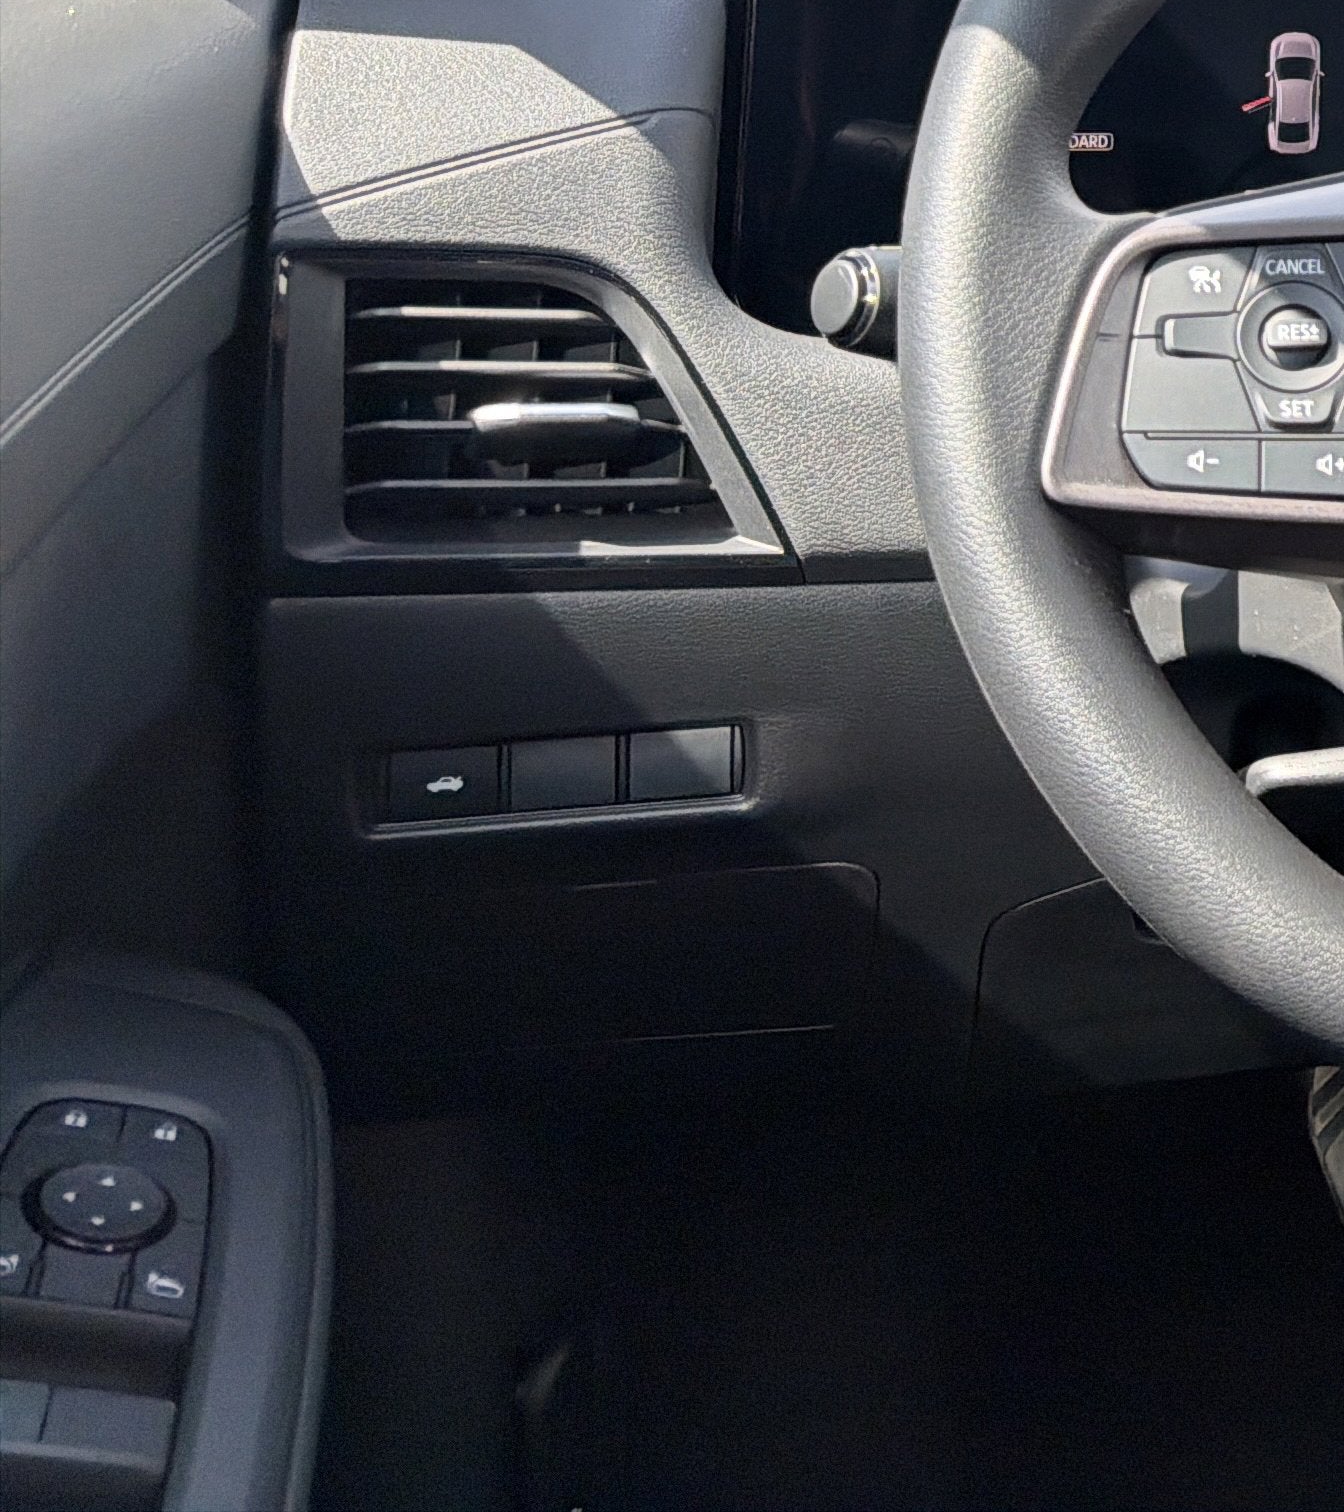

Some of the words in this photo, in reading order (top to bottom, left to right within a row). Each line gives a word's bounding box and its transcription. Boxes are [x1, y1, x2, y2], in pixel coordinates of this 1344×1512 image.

[1069, 135, 1108, 148] DARD
[1265, 258, 1325, 275] CANCEL
[1278, 400, 1314, 418] SET
